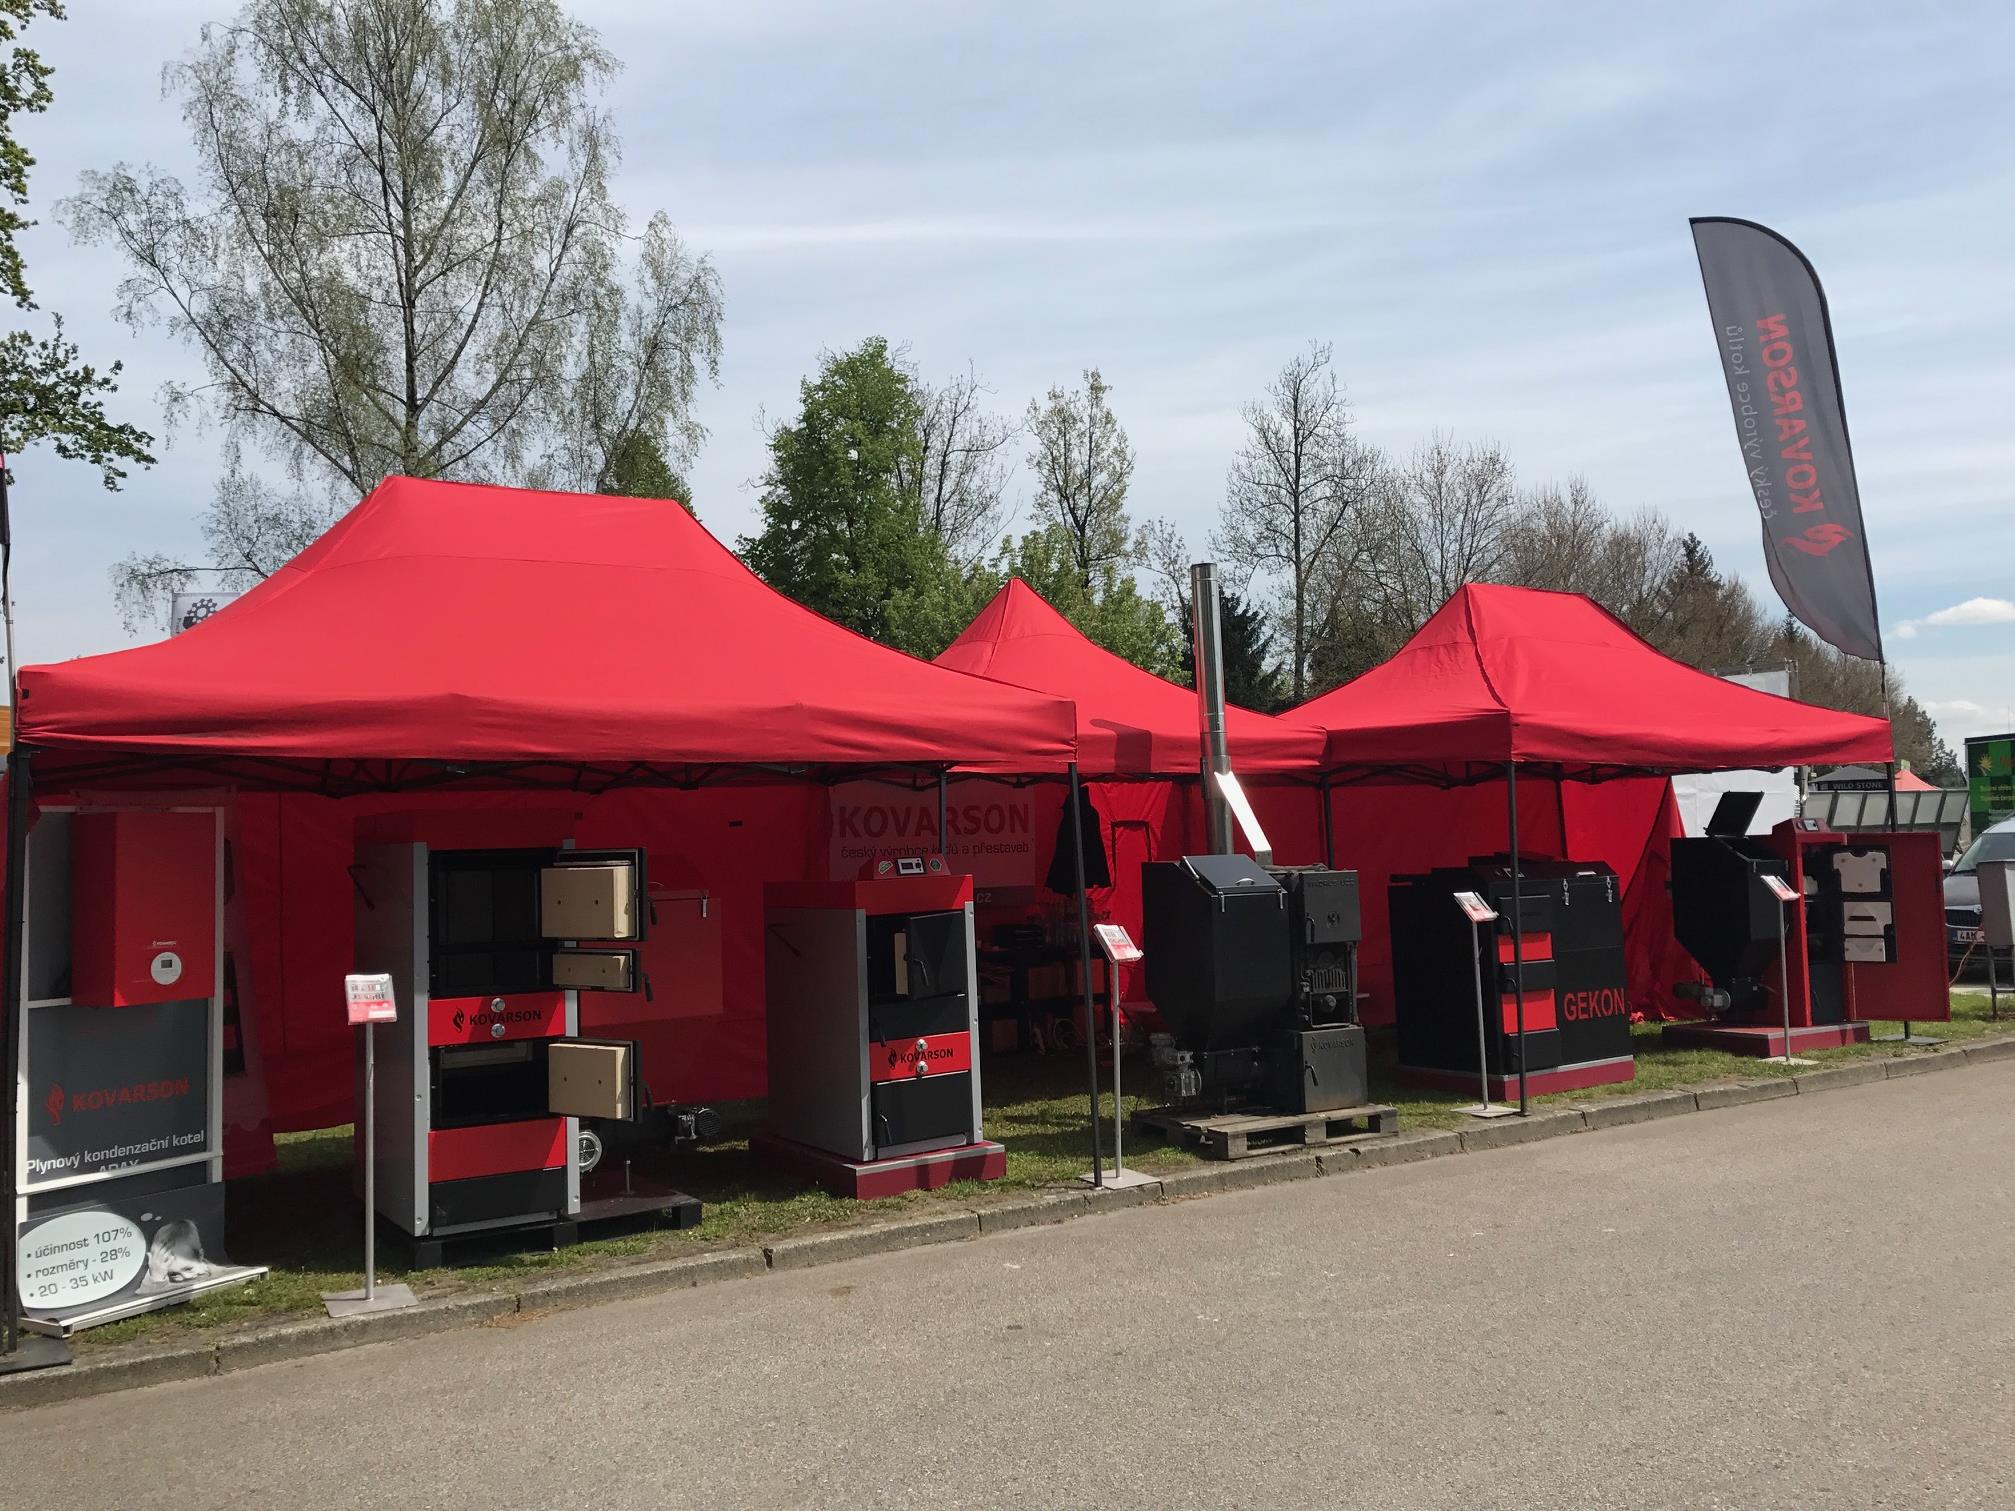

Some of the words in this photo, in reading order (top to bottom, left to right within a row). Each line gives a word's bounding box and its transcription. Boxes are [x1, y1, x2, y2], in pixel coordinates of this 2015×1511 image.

[838, 803, 1029, 839] KOVARSON
[840, 846, 876, 858] český
[931, 842, 959, 856] klů
[961, 845, 970, 855] a
[973, 841, 1029, 857] přestaveb
[470, 1009, 542, 1026] KOVARSON
[1564, 987, 1626, 1021] GEKON
[900, 1048, 953, 1064] KOVARSON
[72, 1077, 189, 1113] KOVARSON
[26, 1152, 81, 1175] Plynový
[84, 1136, 169, 1162] kondenzační
[172, 1130, 205, 1147] kotel
[35, 1237, 90, 1259] účinnost
[93, 1227, 133, 1245] 107%
[35, 1258, 89, 1279] rozměry
[100, 1246, 131, 1263] 28%
[38, 1283, 58, 1297] 20
[69, 1275, 89, 1290] 35
[91, 1269, 114, 1285] kW
